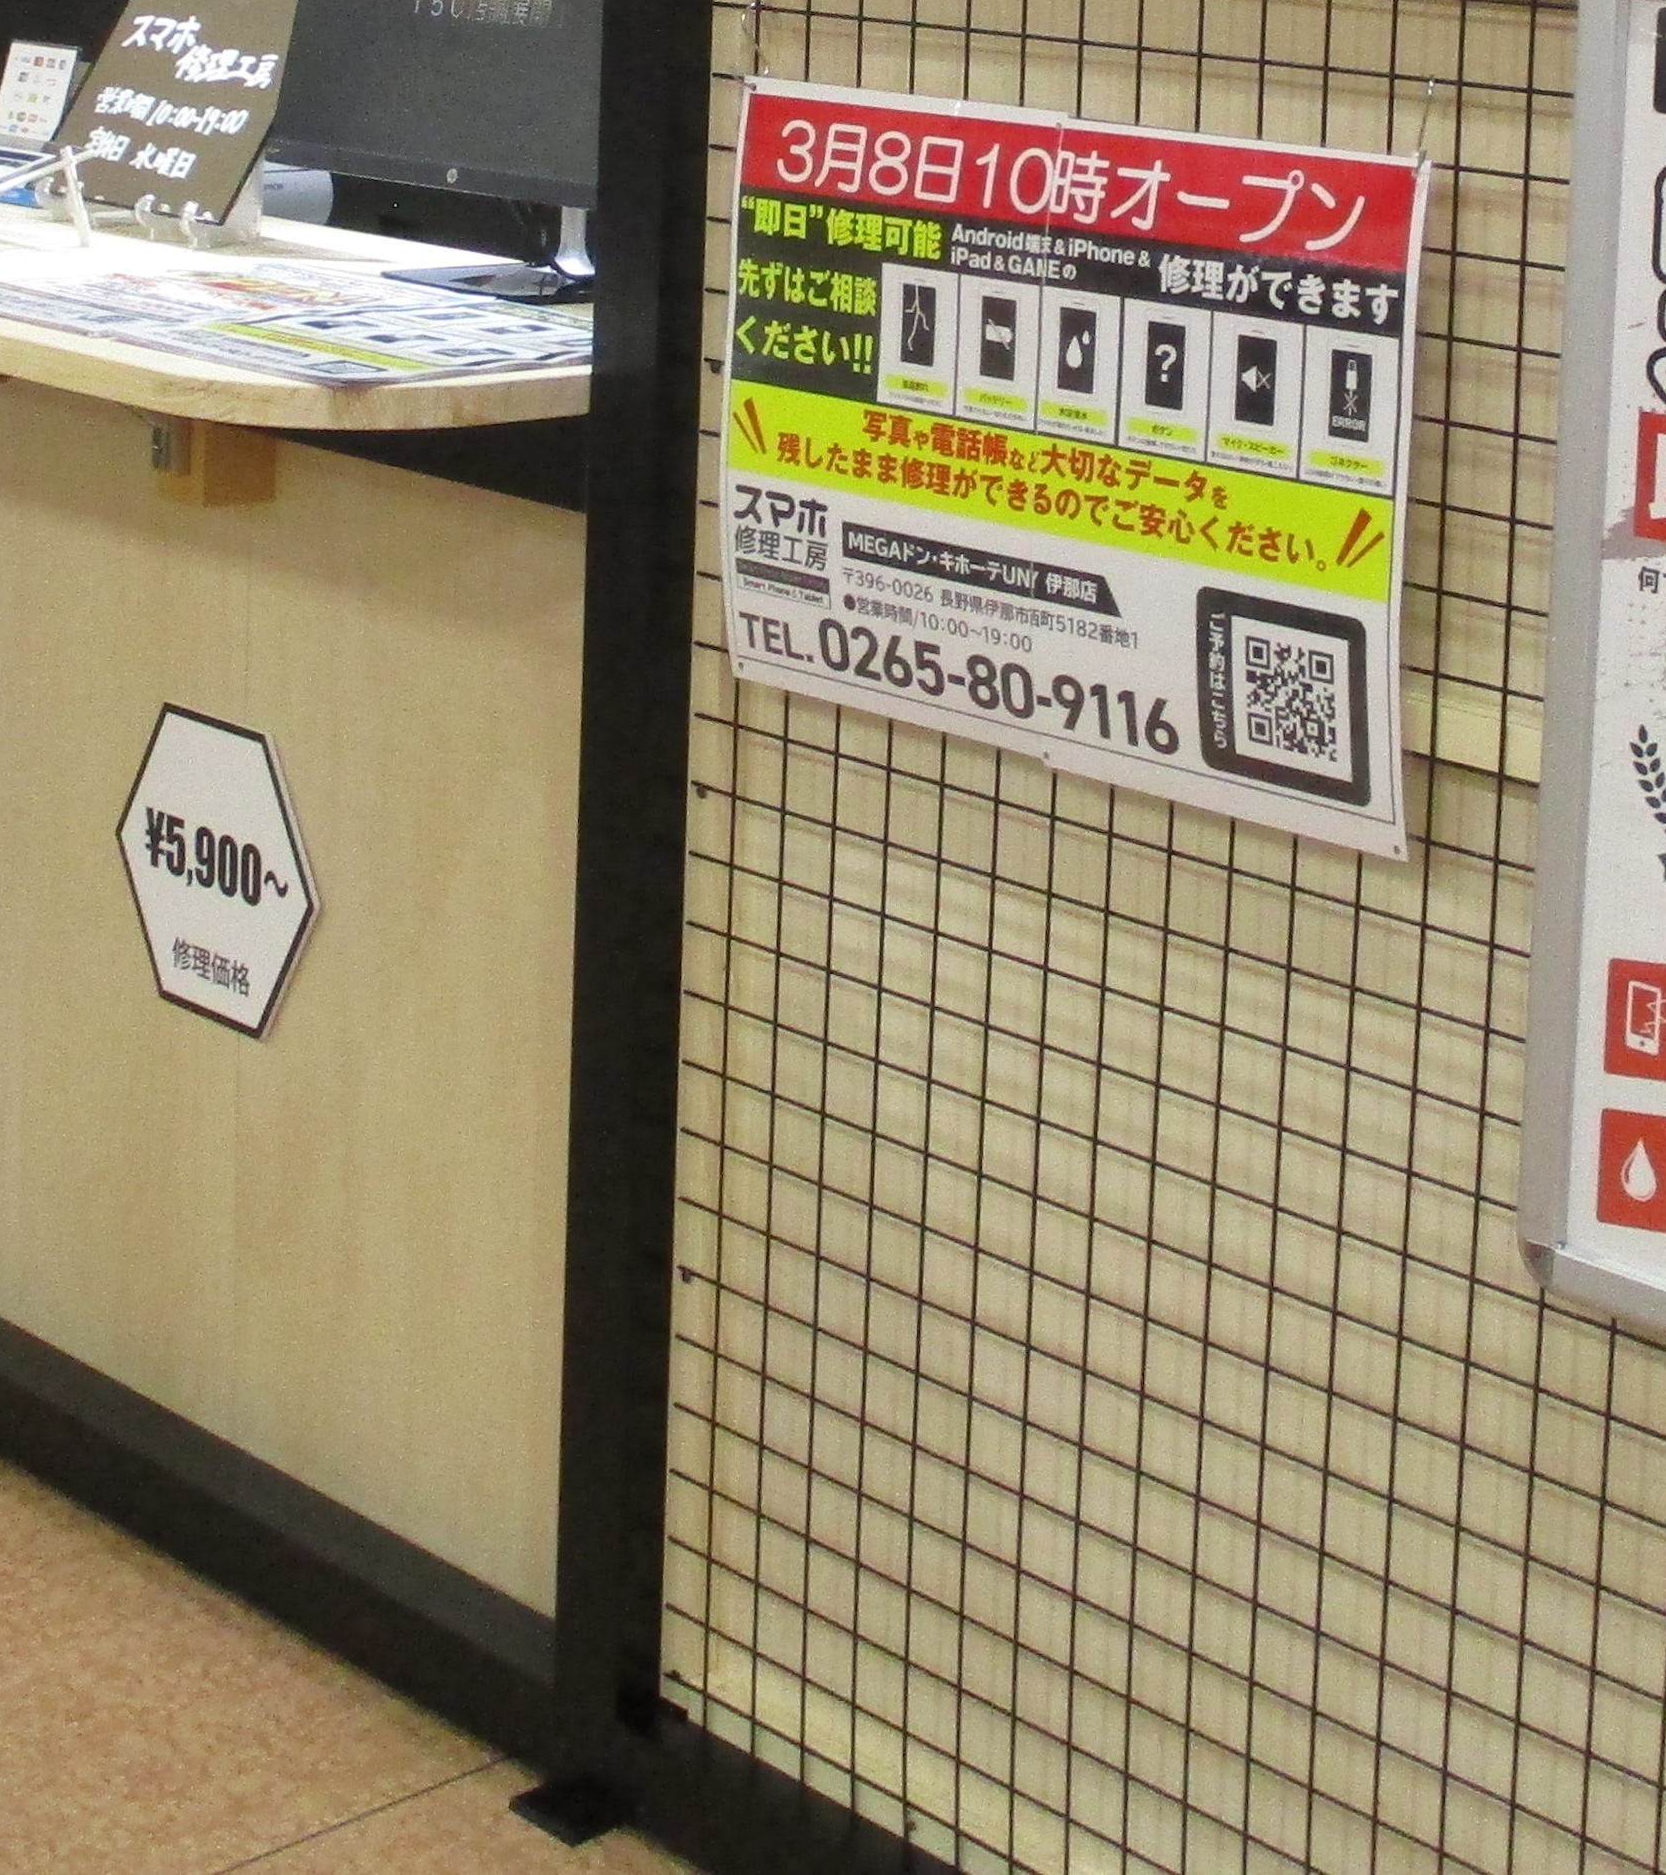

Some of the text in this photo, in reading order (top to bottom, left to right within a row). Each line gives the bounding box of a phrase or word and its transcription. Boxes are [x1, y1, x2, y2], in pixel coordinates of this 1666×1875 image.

[121, 15, 201, 54] スマホ
[175, 44, 280, 90] 修理工房
[130, 142, 197, 179] 水曜日
[775, 118, 1367, 252] 3月8日10時オープン
[950, 246, 991, 270] iPad
[737, 257, 879, 316] 先ずはご相談
[1159, 254, 1400, 327] 修理ができます
[733, 484, 829, 538] スマホ
[734, 525, 829, 572] 修理工房
[1044, 573, 1099, 605] 伊那店
[1207, 612, 1232, 752] ご予約はこちら
[171, 935, 251, 998] 修理価格
